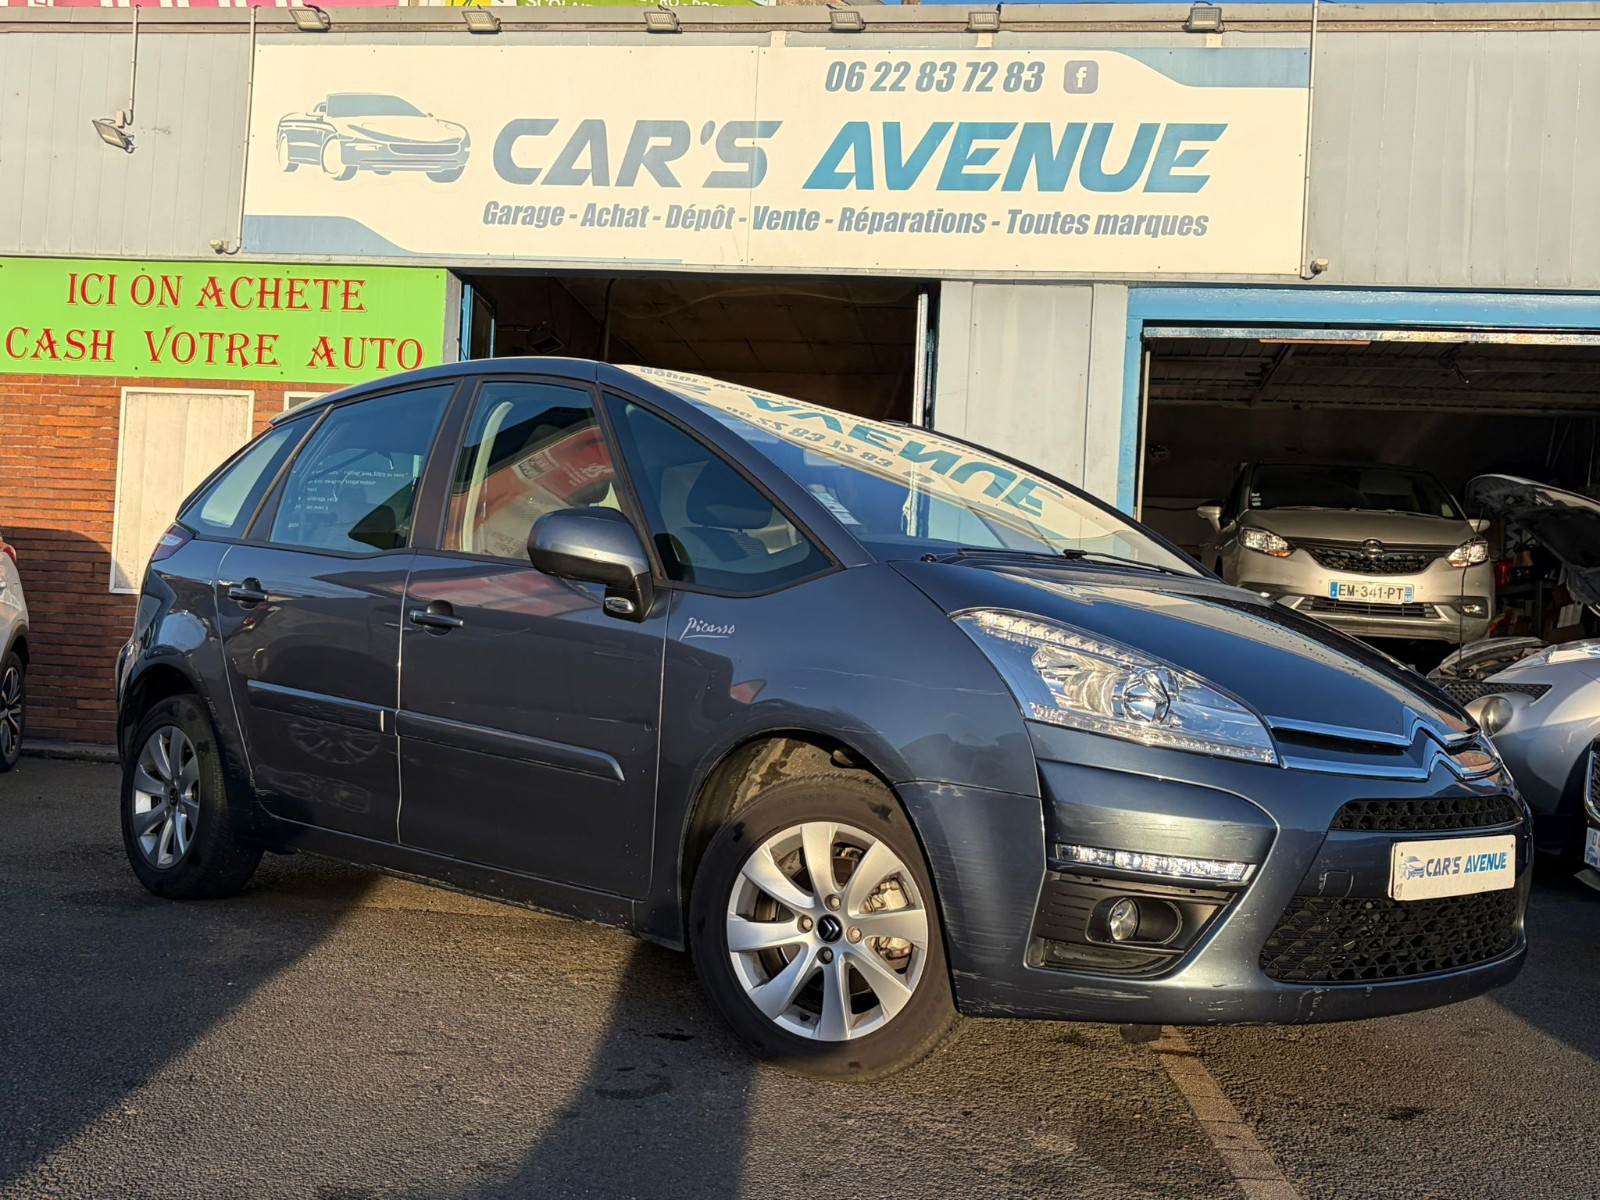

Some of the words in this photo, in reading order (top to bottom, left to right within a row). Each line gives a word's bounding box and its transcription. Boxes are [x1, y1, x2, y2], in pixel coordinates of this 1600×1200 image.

[825, 61, 868, 93] 06
[870, 61, 912, 93] 22
[916, 61, 958, 93] 83
[963, 61, 1000, 93] 72
[1003, 60, 1046, 93] 83
[492, 118, 783, 189] CAR'S
[802, 120, 1228, 194] AVENUE
[482, 201, 566, 229] Garage
[580, 203, 650, 229] Achat
[665, 204, 735, 231] Dépôt
[752, 205, 821, 232] Vente
[838, 207, 988, 235] Réparations
[1007, 208, 1091, 235] Toutes
[1094, 213, 1209, 238] marques
[67, 273, 117, 306] ICI
[130, 274, 184, 309] ON
[196, 276, 367, 313] ACHETE
[5, 326, 116, 363] CASH
[144, 325, 281, 369] VOTRE
[306, 336, 424, 371] AUTO
[1338, 584, 1404, 600] EM-341-PT
[679, 616, 736, 641] Picasso
[1425, 857, 1462, 877] CAR'S
[1464, 852, 1508, 873] AVENUE
